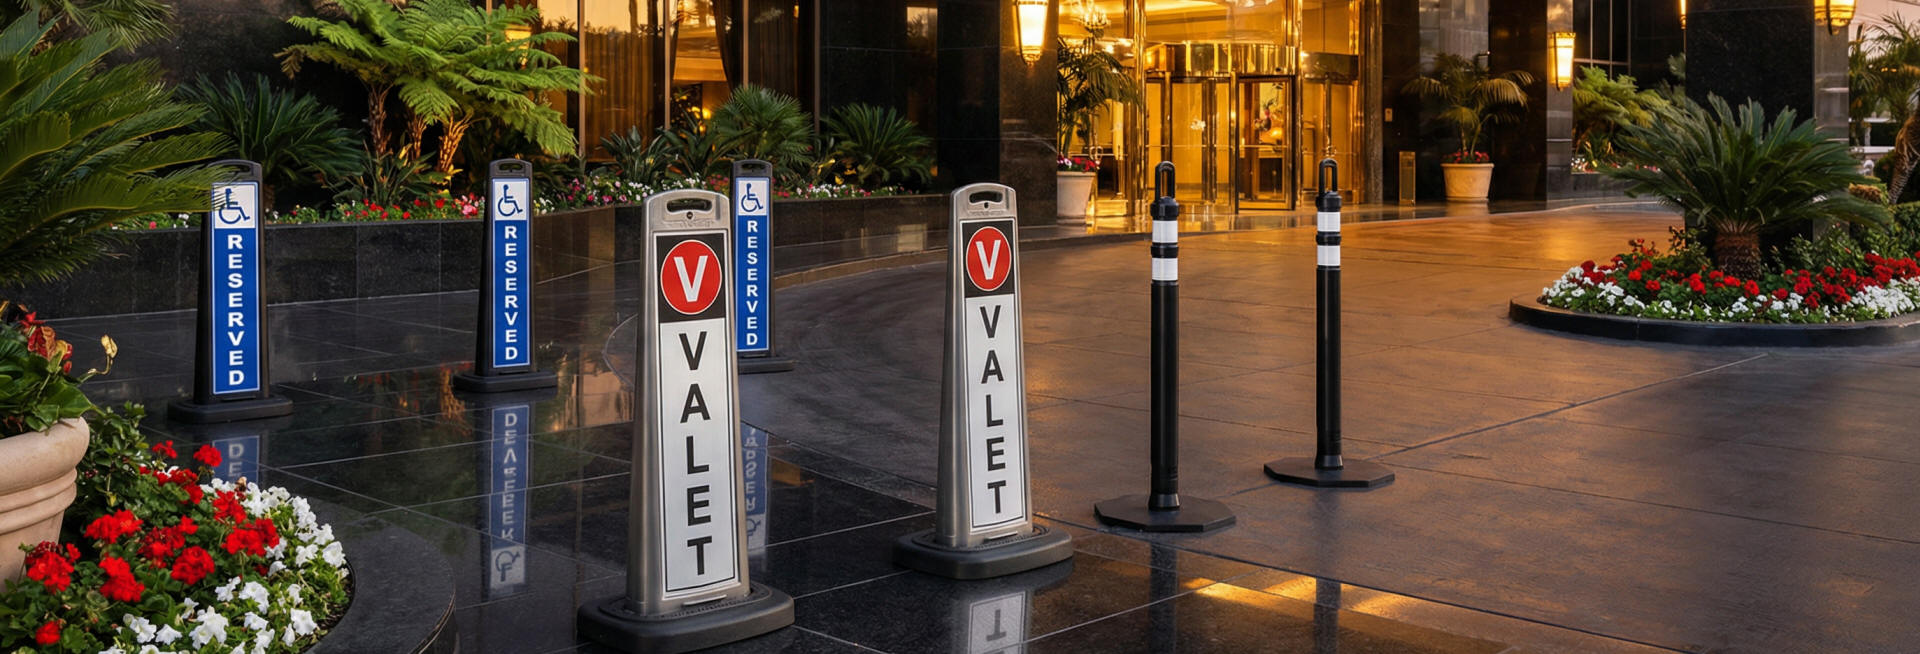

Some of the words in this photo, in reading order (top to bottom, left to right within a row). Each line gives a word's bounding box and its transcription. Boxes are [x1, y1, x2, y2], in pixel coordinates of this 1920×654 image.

[227, 234, 245, 386] RESERVED
[504, 225, 518, 360] RESERVED
[673, 255, 709, 304] V
[747, 220, 758, 346] RESERVED
[975, 239, 1002, 285] V
[679, 332, 713, 577] VALET
[980, 305, 1007, 515] VALET
